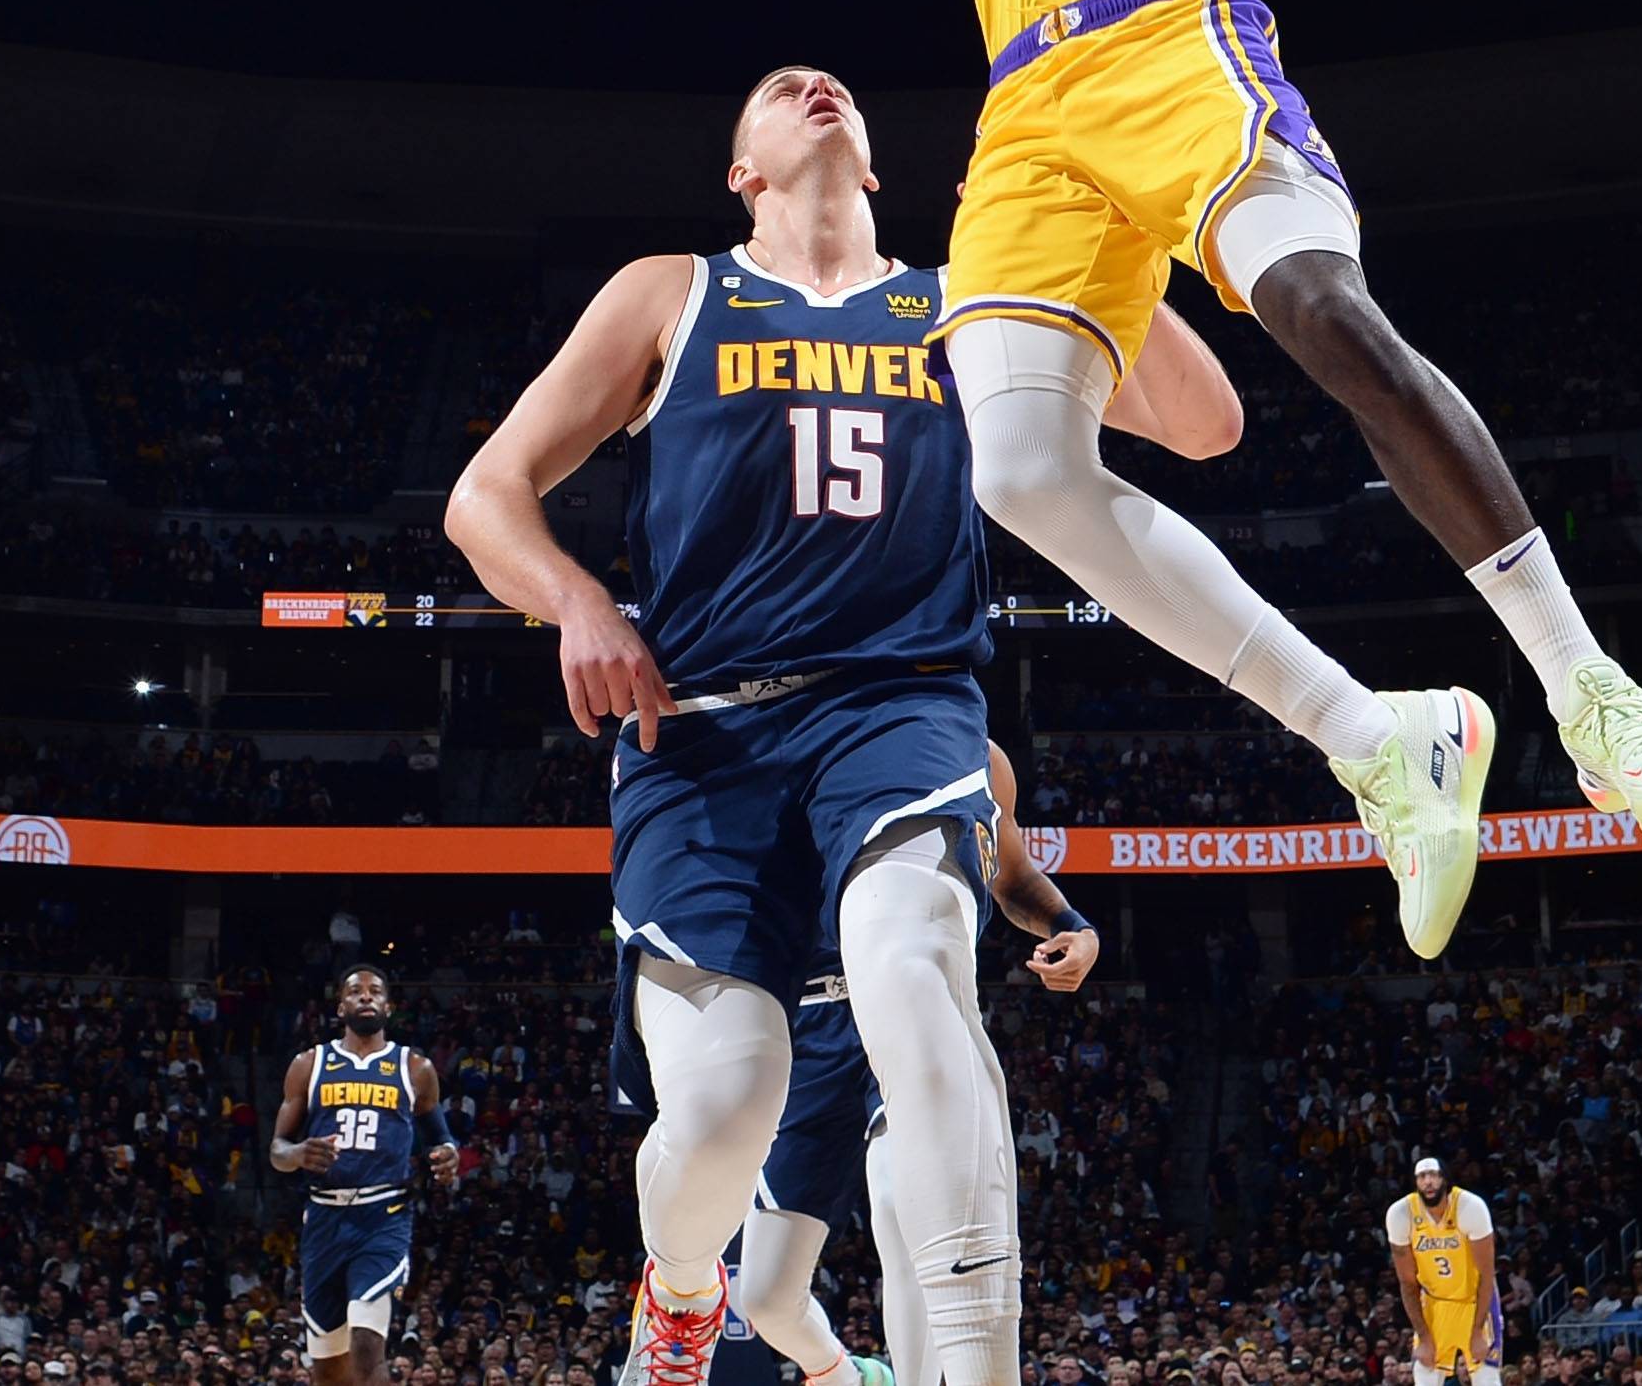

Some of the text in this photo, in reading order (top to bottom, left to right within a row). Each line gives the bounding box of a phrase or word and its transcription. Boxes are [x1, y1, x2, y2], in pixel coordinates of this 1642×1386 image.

[885, 293, 930, 309] WU
[716, 339, 944, 406] DENVER
[788, 406, 885, 518] 15
[416, 595, 434, 609] 20
[1007, 596, 1017, 609] 0
[415, 612, 434, 626] 22
[1008, 615, 1015, 627] 1
[1110, 812, 1638, 868] BRECKENRID REWERY
[320, 1082, 399, 1110] DENVER
[336, 1108, 379, 1150] 32
[1434, 1256, 1451, 1276] 3
